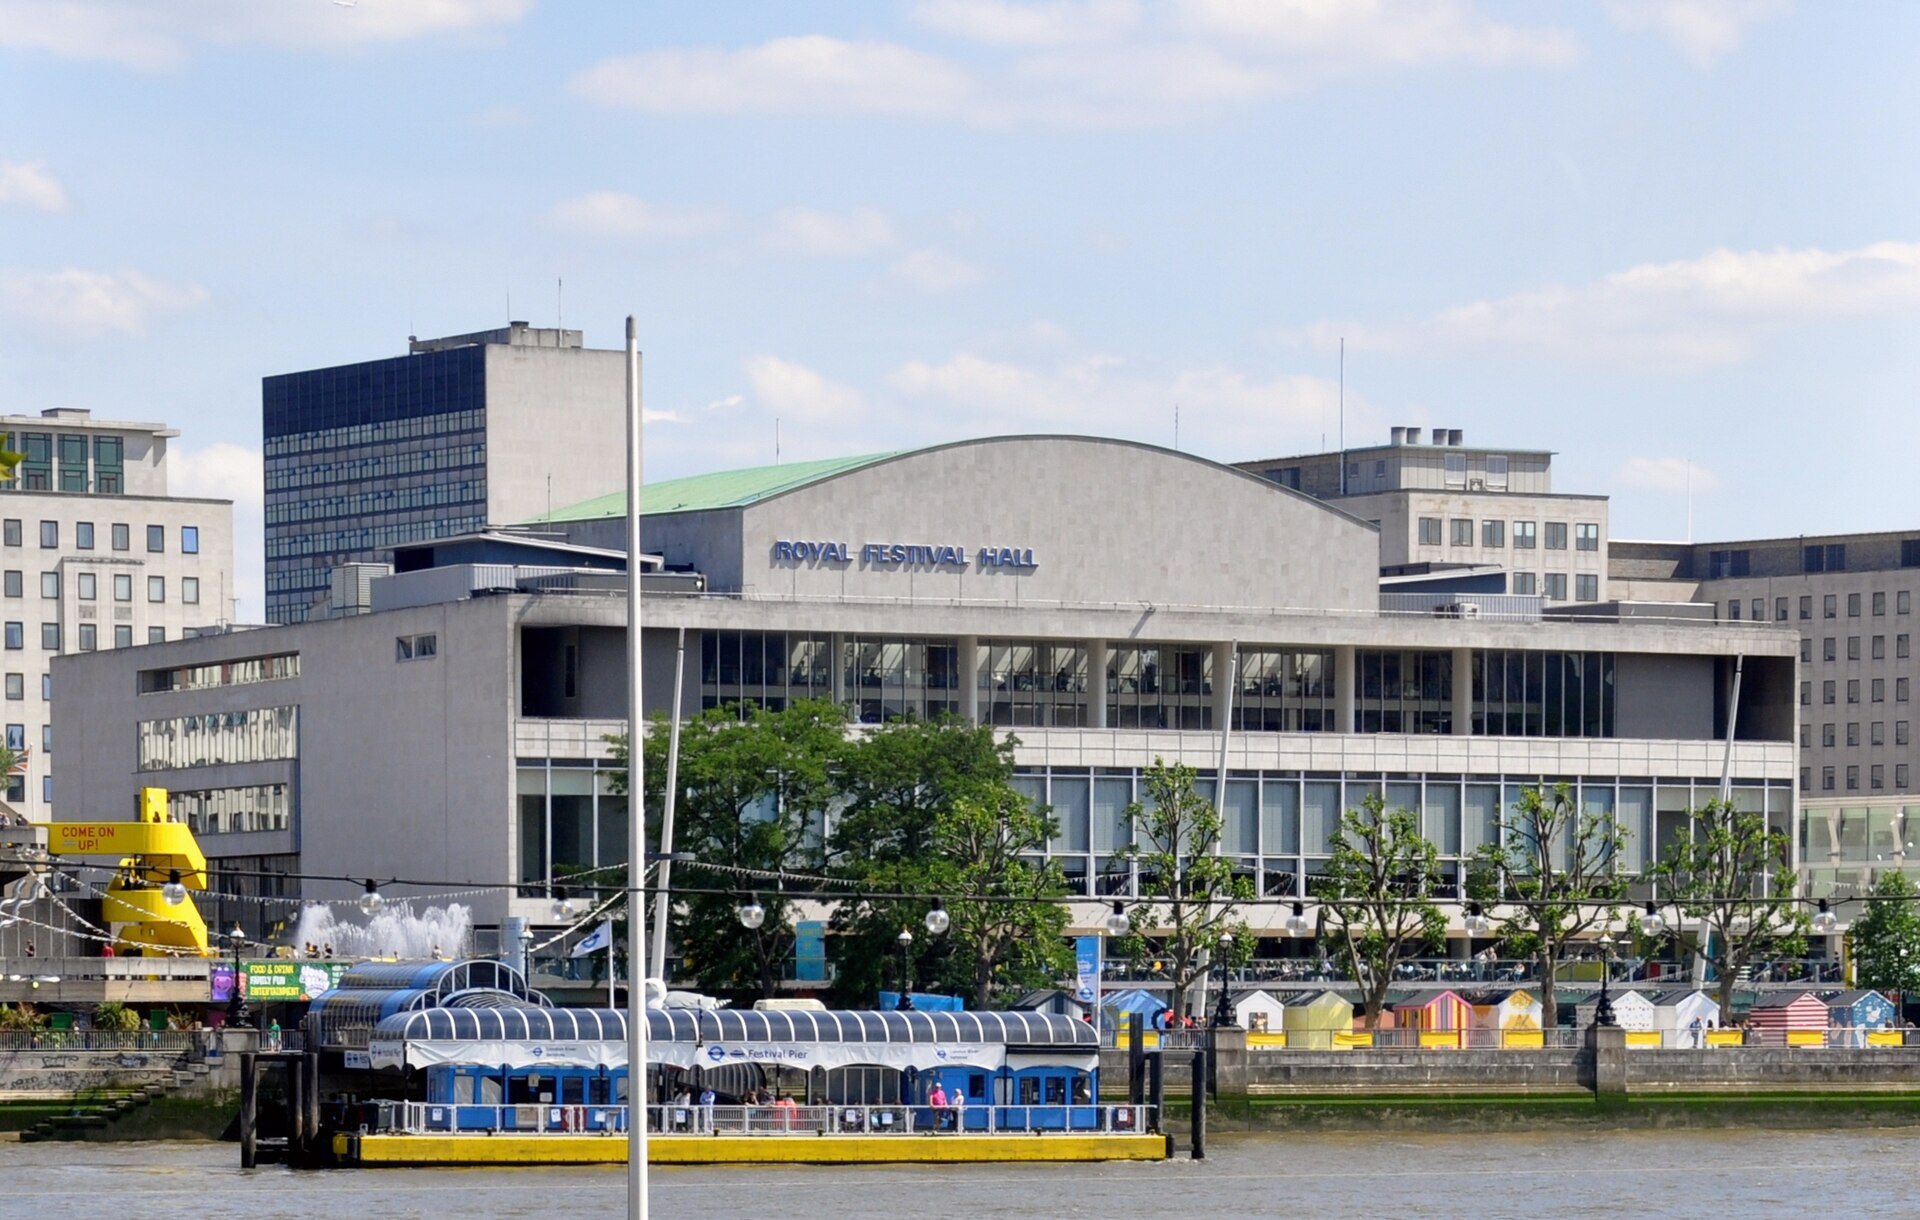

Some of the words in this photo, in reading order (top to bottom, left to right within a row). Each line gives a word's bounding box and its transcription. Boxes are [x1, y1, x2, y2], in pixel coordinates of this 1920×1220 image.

[775, 539, 853, 561] ROYAL
[864, 542, 970, 566] FESTIVAL
[980, 545, 1039, 567] HALL
[62, 826, 95, 838] COME
[98, 826, 115, 838] ON
[78, 839, 99, 851] UP!
[249, 964, 266, 975] FOOD
[748, 1049, 786, 1059] Festival
[788, 1049, 808, 1059] Pier
